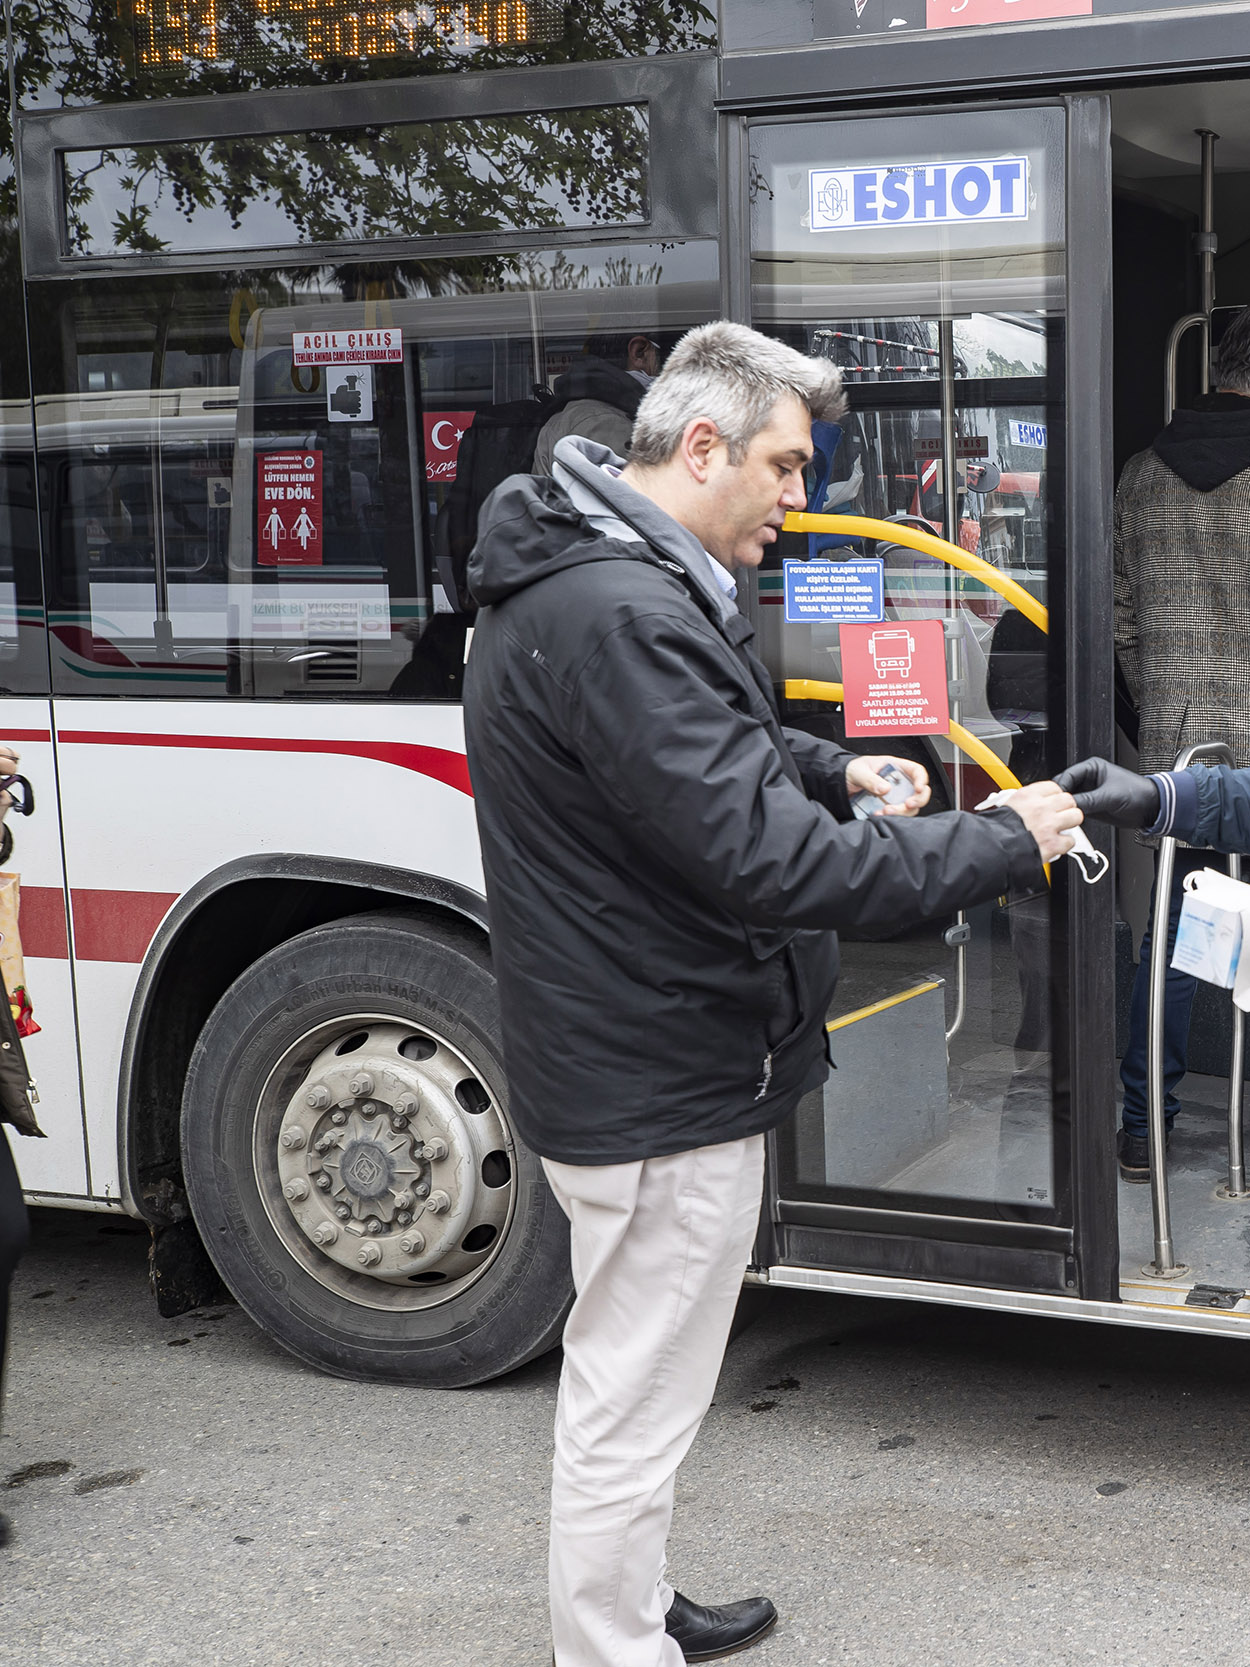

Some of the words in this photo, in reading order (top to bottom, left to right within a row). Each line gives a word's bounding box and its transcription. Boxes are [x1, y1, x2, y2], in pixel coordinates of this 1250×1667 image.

[853, 163, 1021, 222] ESHOT
[303, 333, 338, 349] ACİL
[347, 332, 392, 349] ÇIKIŞ
[1018, 424, 1047, 448] ESHOT
[264, 472, 289, 482] LÜTFEN
[290, 473, 315, 482] HEMEN
[264, 487, 284, 500] EVE
[286, 483, 315, 500] DÖN.
[831, 566, 856, 574] ULAŞIM
[806, 575, 829, 584] KİŞİYE
[862, 698, 893, 707] SAATLERİ
[895, 698, 929, 706] ARASINDA
[869, 708, 895, 717] HALK
[895, 707, 923, 717] TAŞIT
[855, 718, 899, 727] UYGULAMASI
[899, 716, 938, 726] GEÇERLİDİR
